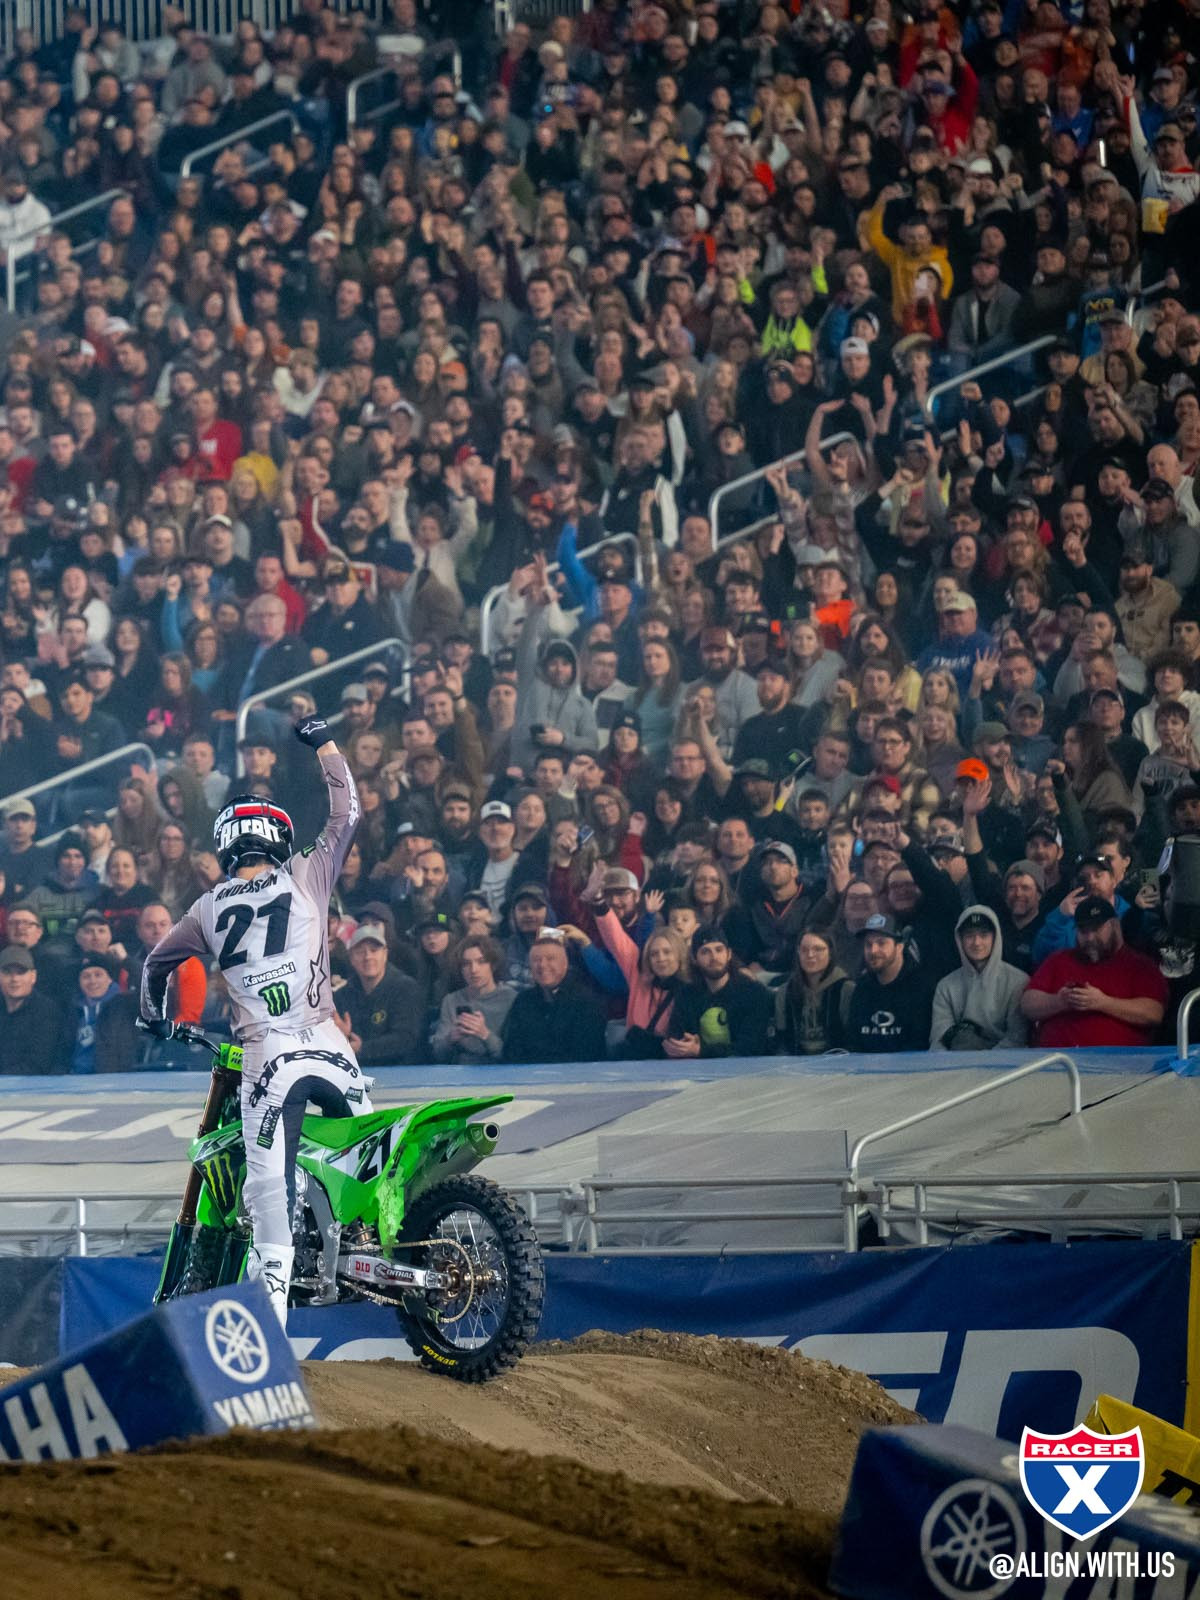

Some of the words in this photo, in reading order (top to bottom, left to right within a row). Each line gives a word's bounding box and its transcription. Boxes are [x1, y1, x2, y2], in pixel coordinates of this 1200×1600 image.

[215, 872, 278, 902] ANDERSON
[215, 892, 292, 971] 21
[243, 962, 296, 988] Kawasaki
[213, 1381, 311, 1427] YAMAHA
